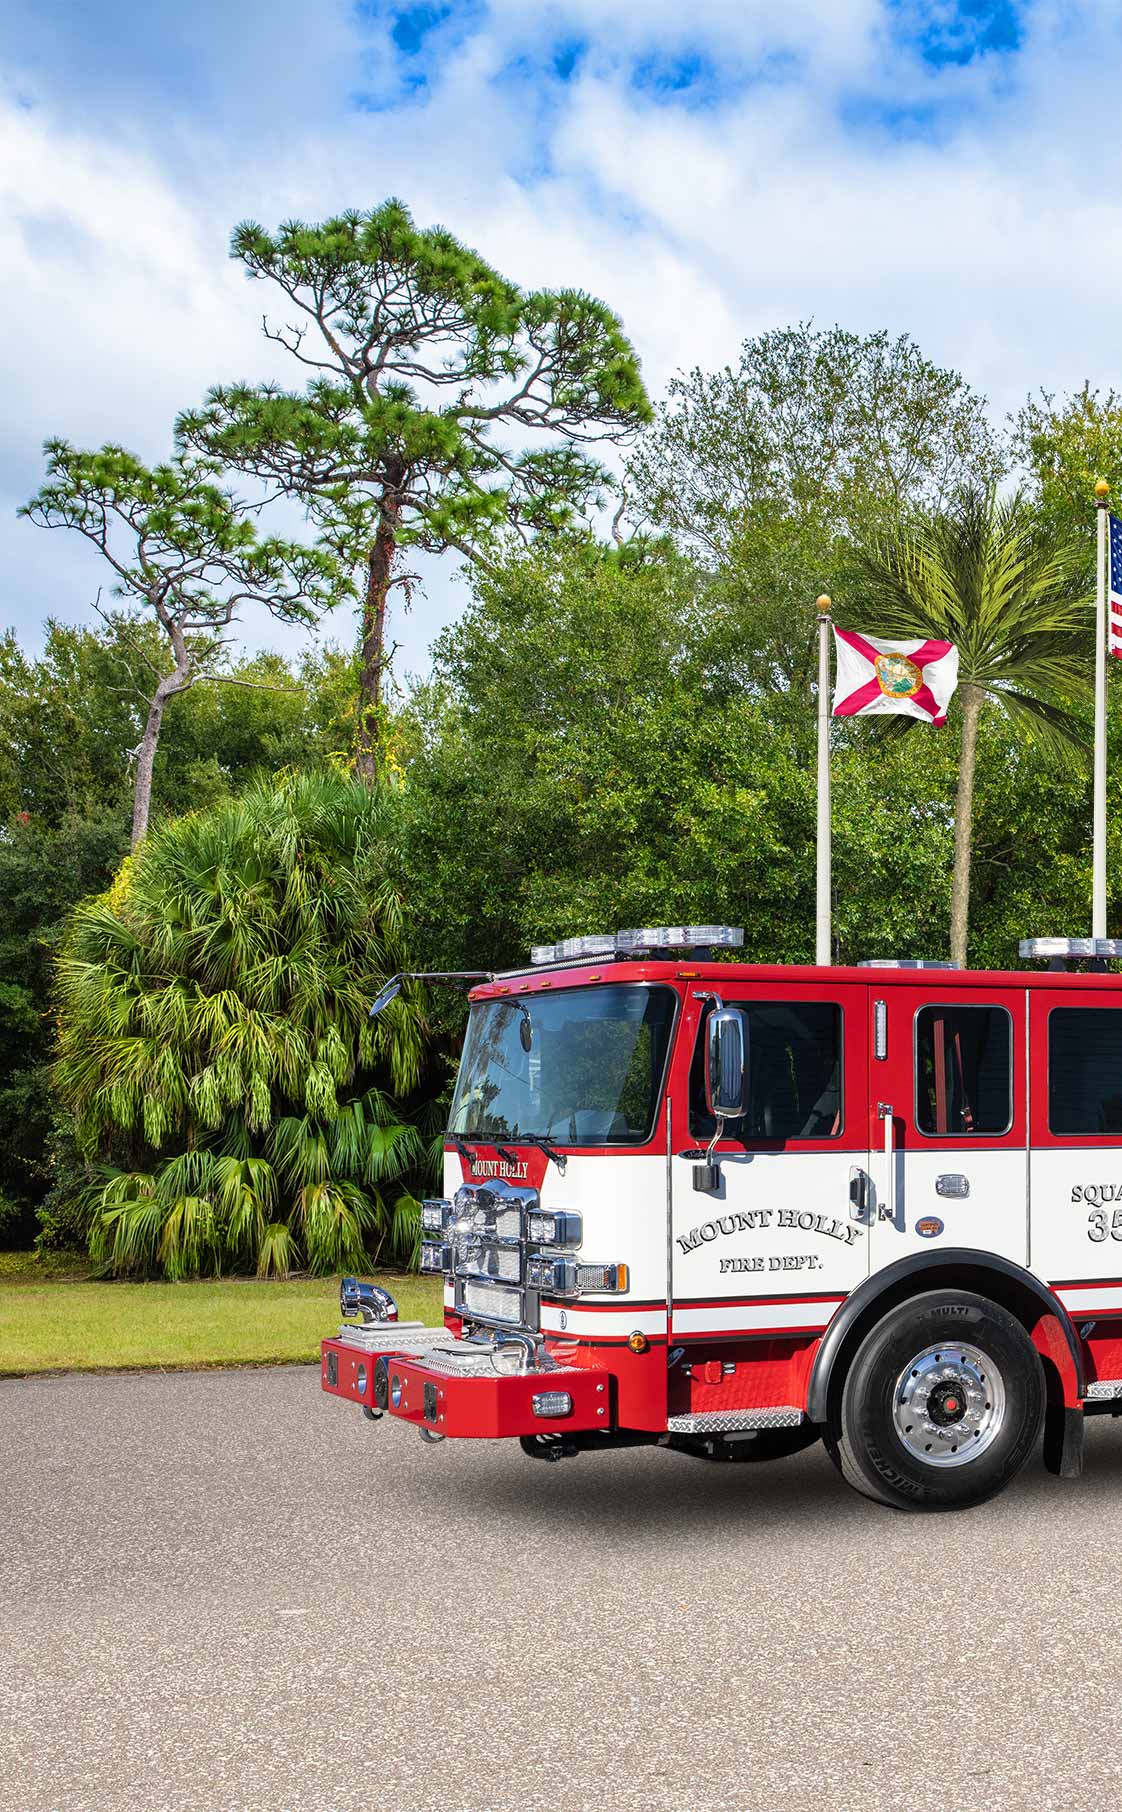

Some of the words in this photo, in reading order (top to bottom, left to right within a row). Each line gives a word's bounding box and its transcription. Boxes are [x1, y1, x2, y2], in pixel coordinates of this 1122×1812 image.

[471, 1160, 498, 1177] MOUNT
[499, 1161, 529, 1179] HOLLY
[676, 1208, 774, 1255] MOUNT
[777, 1208, 865, 1246] HOLLY
[719, 1256, 765, 1274] FIRE
[768, 1254, 824, 1272] DEPT.
